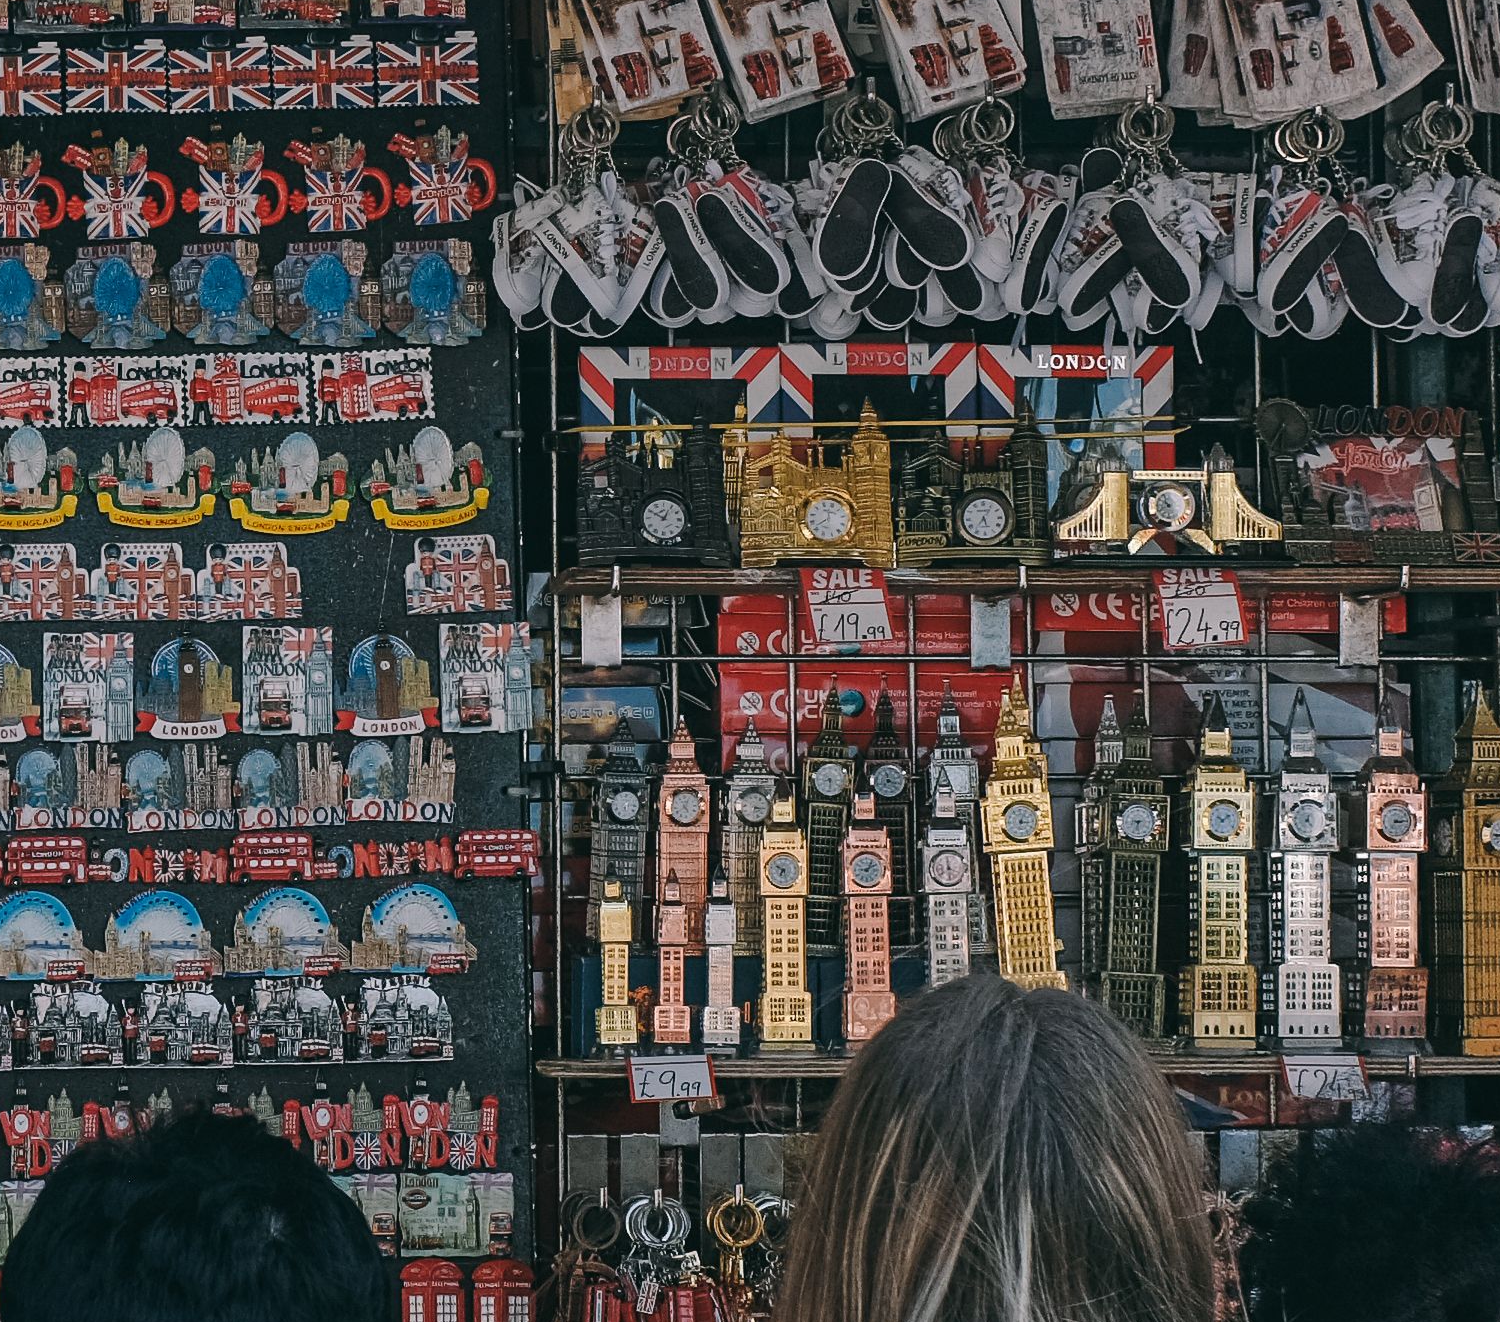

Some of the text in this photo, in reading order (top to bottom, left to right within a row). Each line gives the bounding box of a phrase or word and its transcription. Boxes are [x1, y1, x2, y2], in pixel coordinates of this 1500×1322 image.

[1017, 219, 1040, 262] LONDON
[637, 354, 727, 371] LONDON
[832, 350, 923, 367] LONDON
[1037, 353, 1126, 371] LONDON
[812, 569, 873, 589] SALE
[1162, 567, 1222, 584] SALE
[817, 612, 886, 641] £19.99
[1164, 607, 1240, 646] £24.99
[161, 723, 218, 737] LONDON
[128, 810, 235, 832] LONDON
[346, 800, 455, 822] LONDON
[638, 1069, 702, 1099] £9.99
